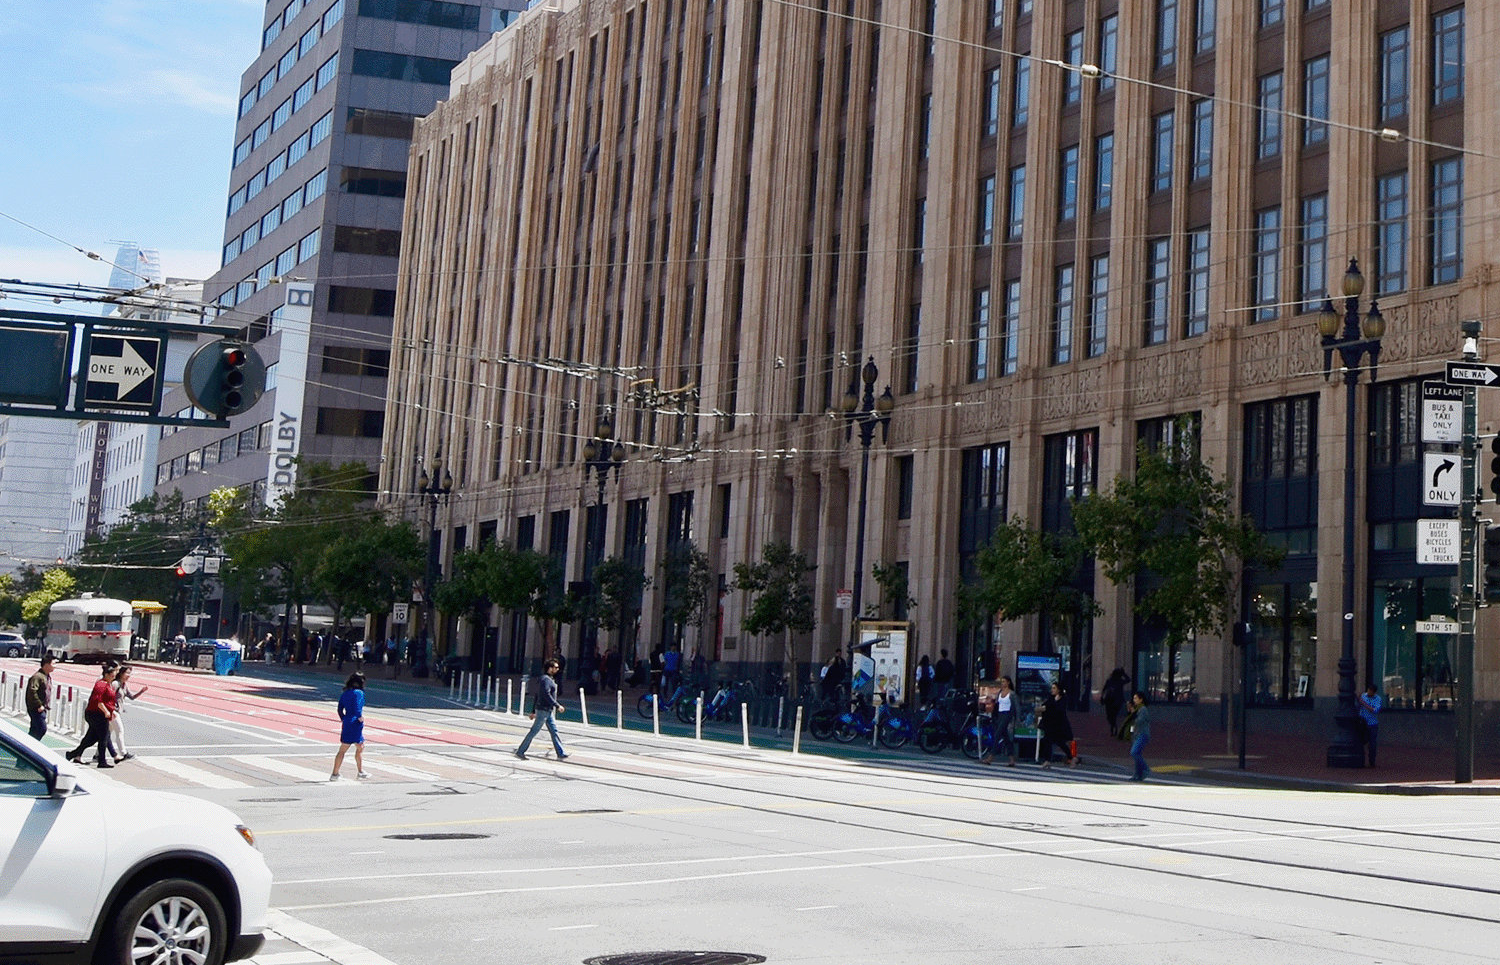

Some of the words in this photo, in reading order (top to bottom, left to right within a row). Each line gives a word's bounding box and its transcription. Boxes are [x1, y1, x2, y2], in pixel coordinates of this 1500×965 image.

[91, 363, 115, 375] ONE
[124, 366, 148, 377] WAY
[1453, 369, 1468, 378] ONE
[94, 426, 106, 480] HOTEL
[274, 411, 297, 487] DOLBY
[1429, 490, 1456, 500] ONLY
[1429, 522, 1449, 530] EXCEPT
[1430, 530, 1448, 538] BUSES
[1426, 538, 1452, 546] BICYCLES
[1431, 546, 1447, 554] TAXIS
[1444, 624, 1452, 632] ST
